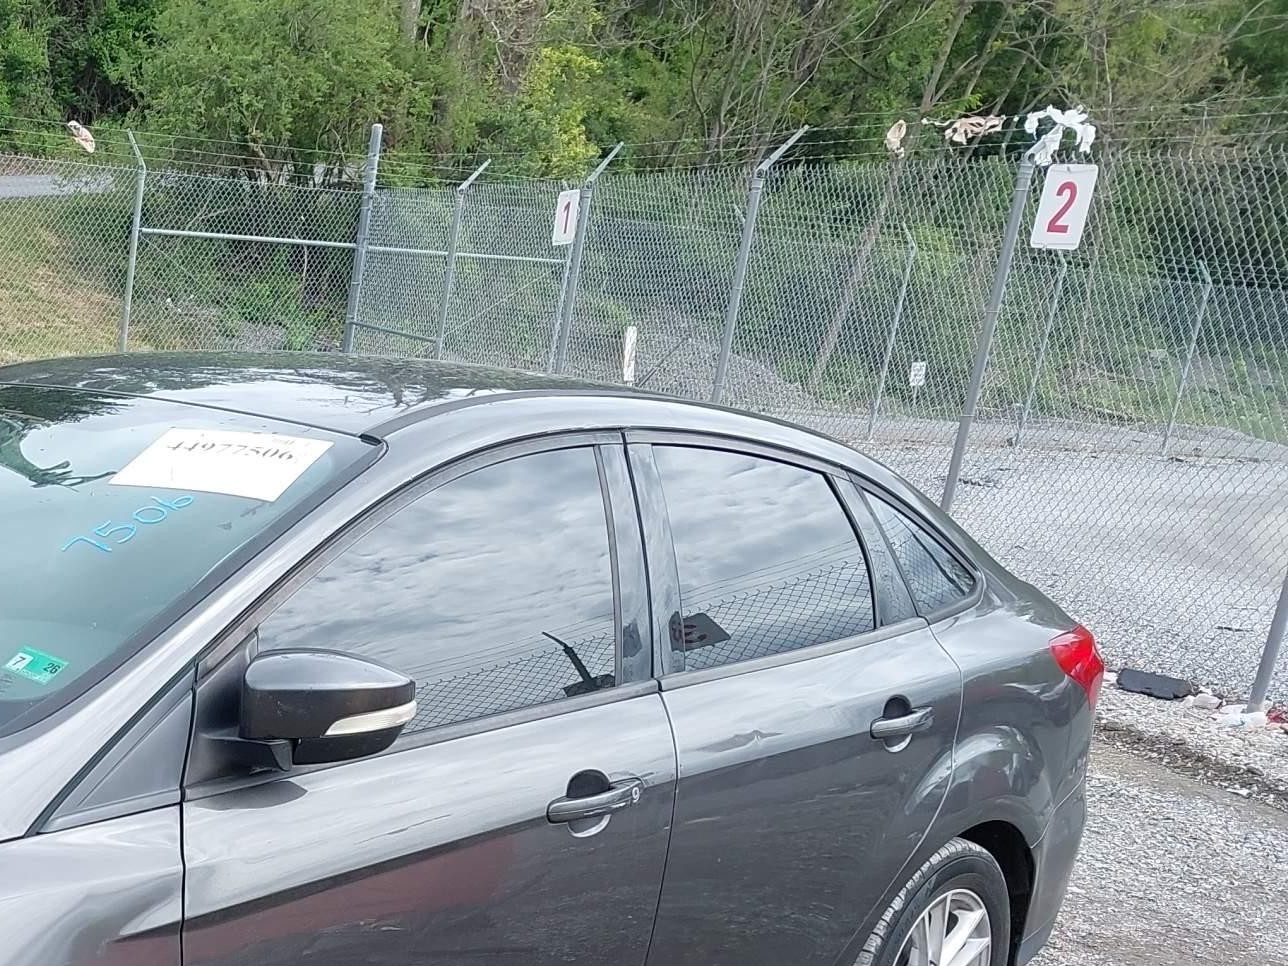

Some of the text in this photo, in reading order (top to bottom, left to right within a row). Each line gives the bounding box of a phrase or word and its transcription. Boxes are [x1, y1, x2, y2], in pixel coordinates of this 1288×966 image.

[562, 201, 571, 234] 1
[1046, 181, 1078, 233] 2
[167, 440, 295, 462] 44977506
[61, 494, 195, 553] 7506
[12, 656, 61, 675] 7 26
